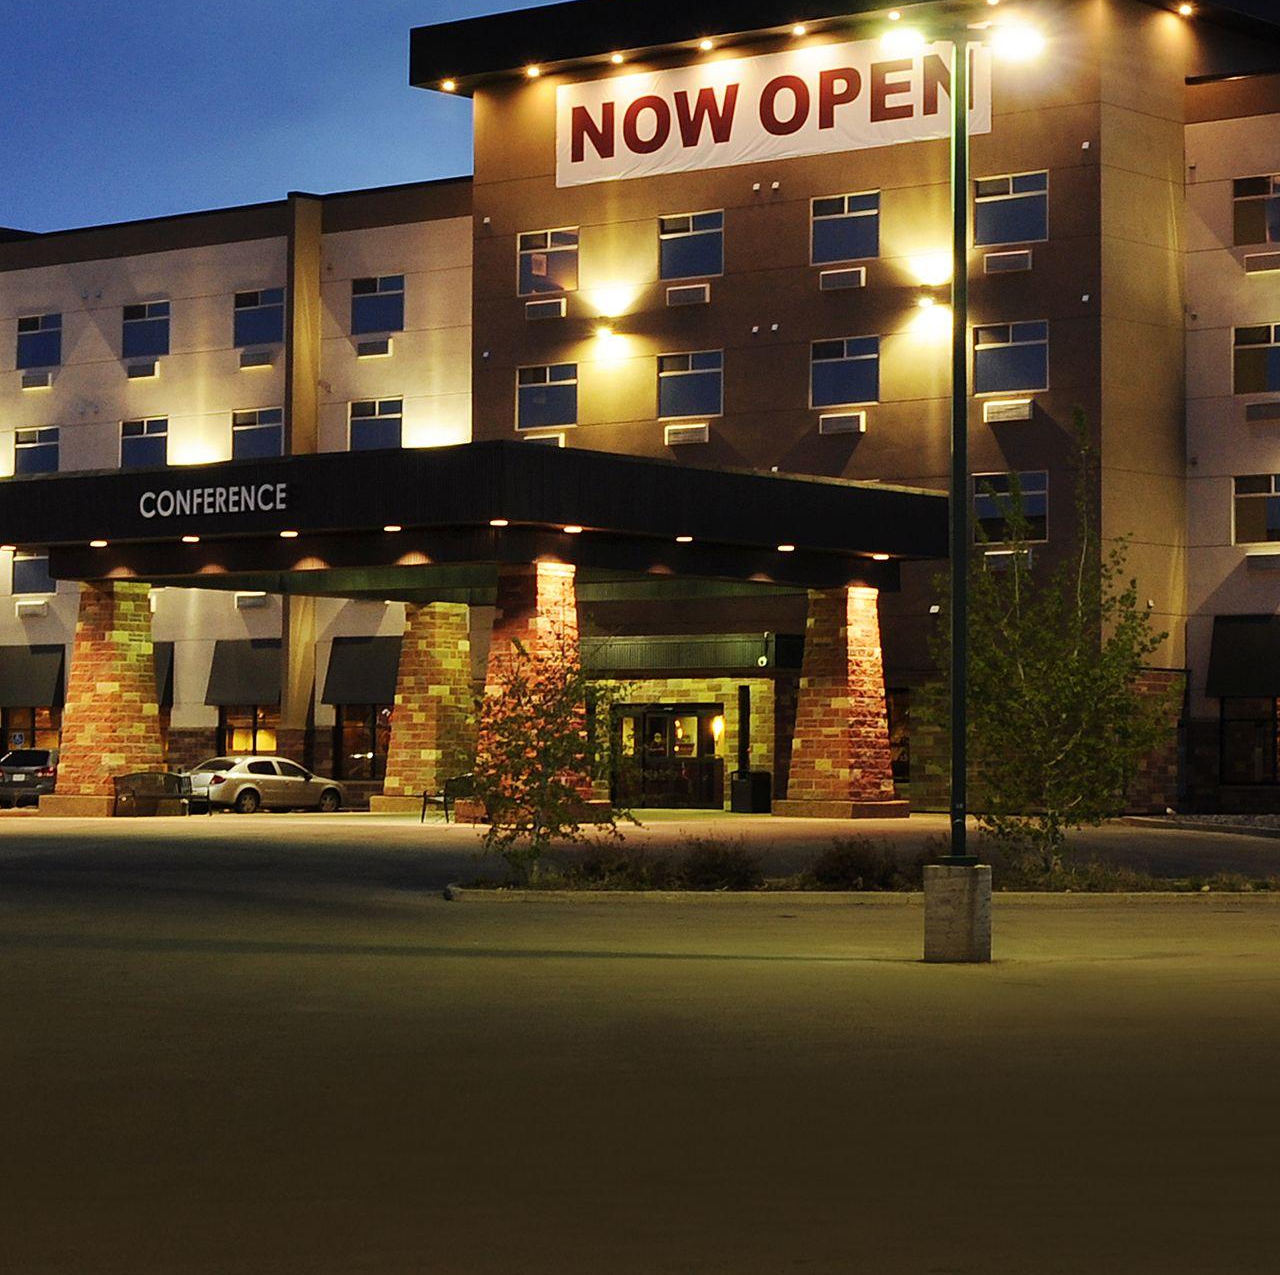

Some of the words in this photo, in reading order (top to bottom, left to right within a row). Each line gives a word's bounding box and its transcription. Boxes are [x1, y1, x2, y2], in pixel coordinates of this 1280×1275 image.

[570, 83, 739, 164] NOW
[758, 49, 974, 136] OPEN
[139, 483, 287, 518] CONFERENCE
